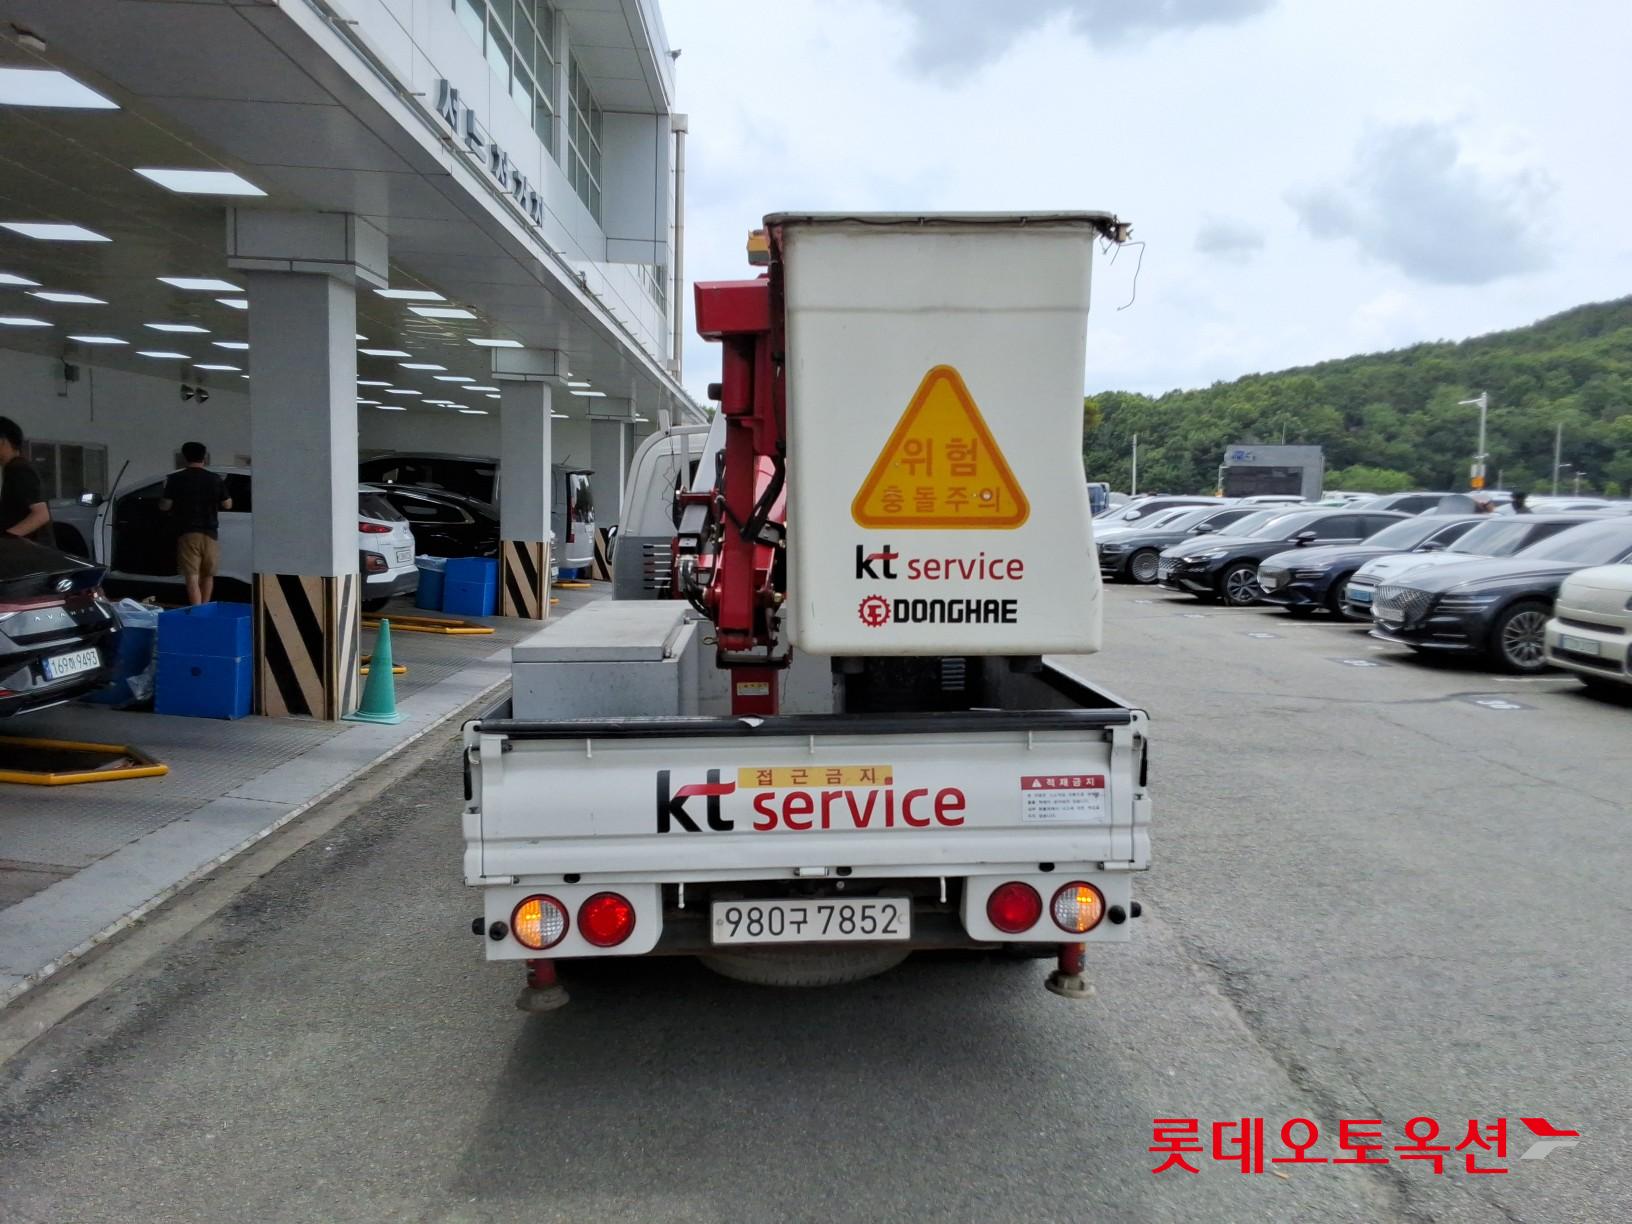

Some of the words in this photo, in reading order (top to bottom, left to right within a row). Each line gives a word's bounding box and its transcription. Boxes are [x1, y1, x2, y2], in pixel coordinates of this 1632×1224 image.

[901, 437, 978, 478] 위험
[881, 485, 1001, 514] 충돌주의
[855, 544, 899, 580] kt
[907, 552, 1024, 581] service
[893, 599, 1018, 624] DONGHAE
[755, 767, 879, 787] 접근금지
[656, 768, 736, 834] kt
[753, 776, 966, 832] service
